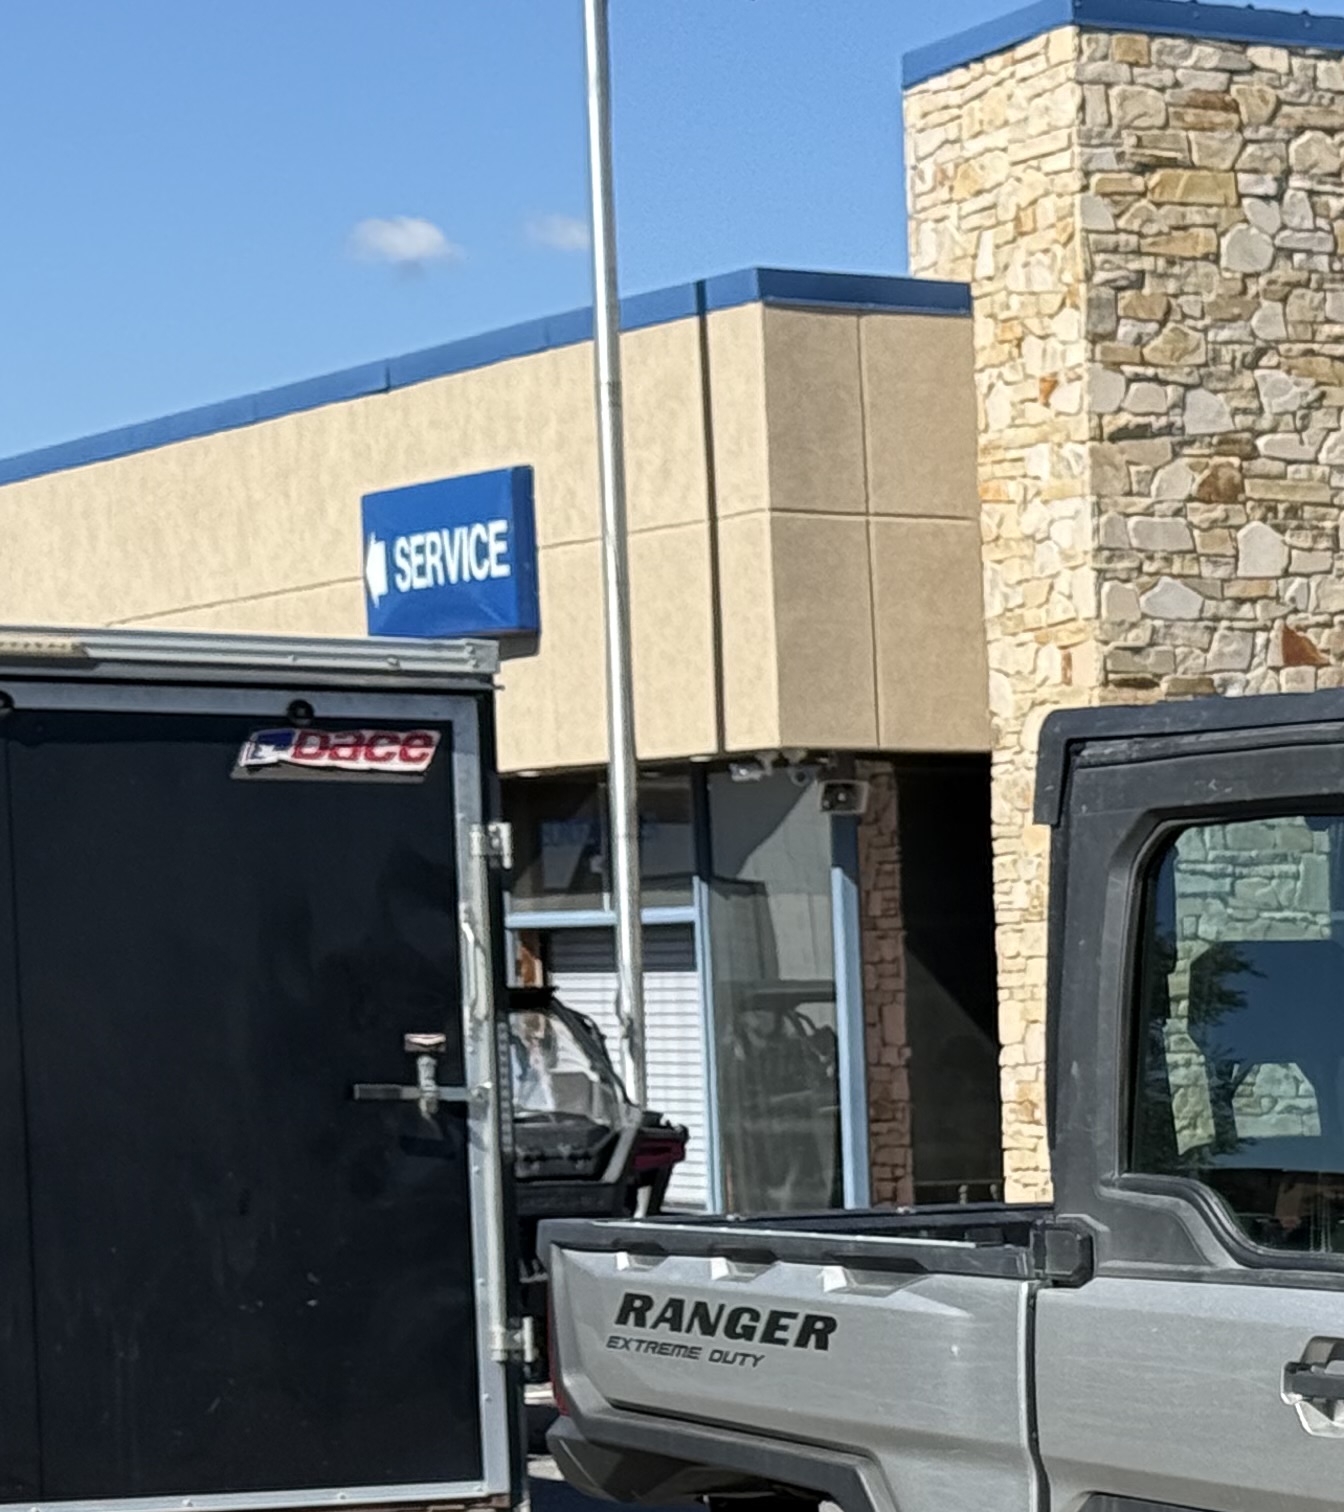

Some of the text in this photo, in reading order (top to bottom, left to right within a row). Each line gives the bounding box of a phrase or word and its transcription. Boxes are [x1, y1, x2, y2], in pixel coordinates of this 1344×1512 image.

[394, 519, 512, 593] SERVICE
[605, 1335, 766, 1369] EXTREME DUTY
[614, 1291, 838, 1352] RANGER
